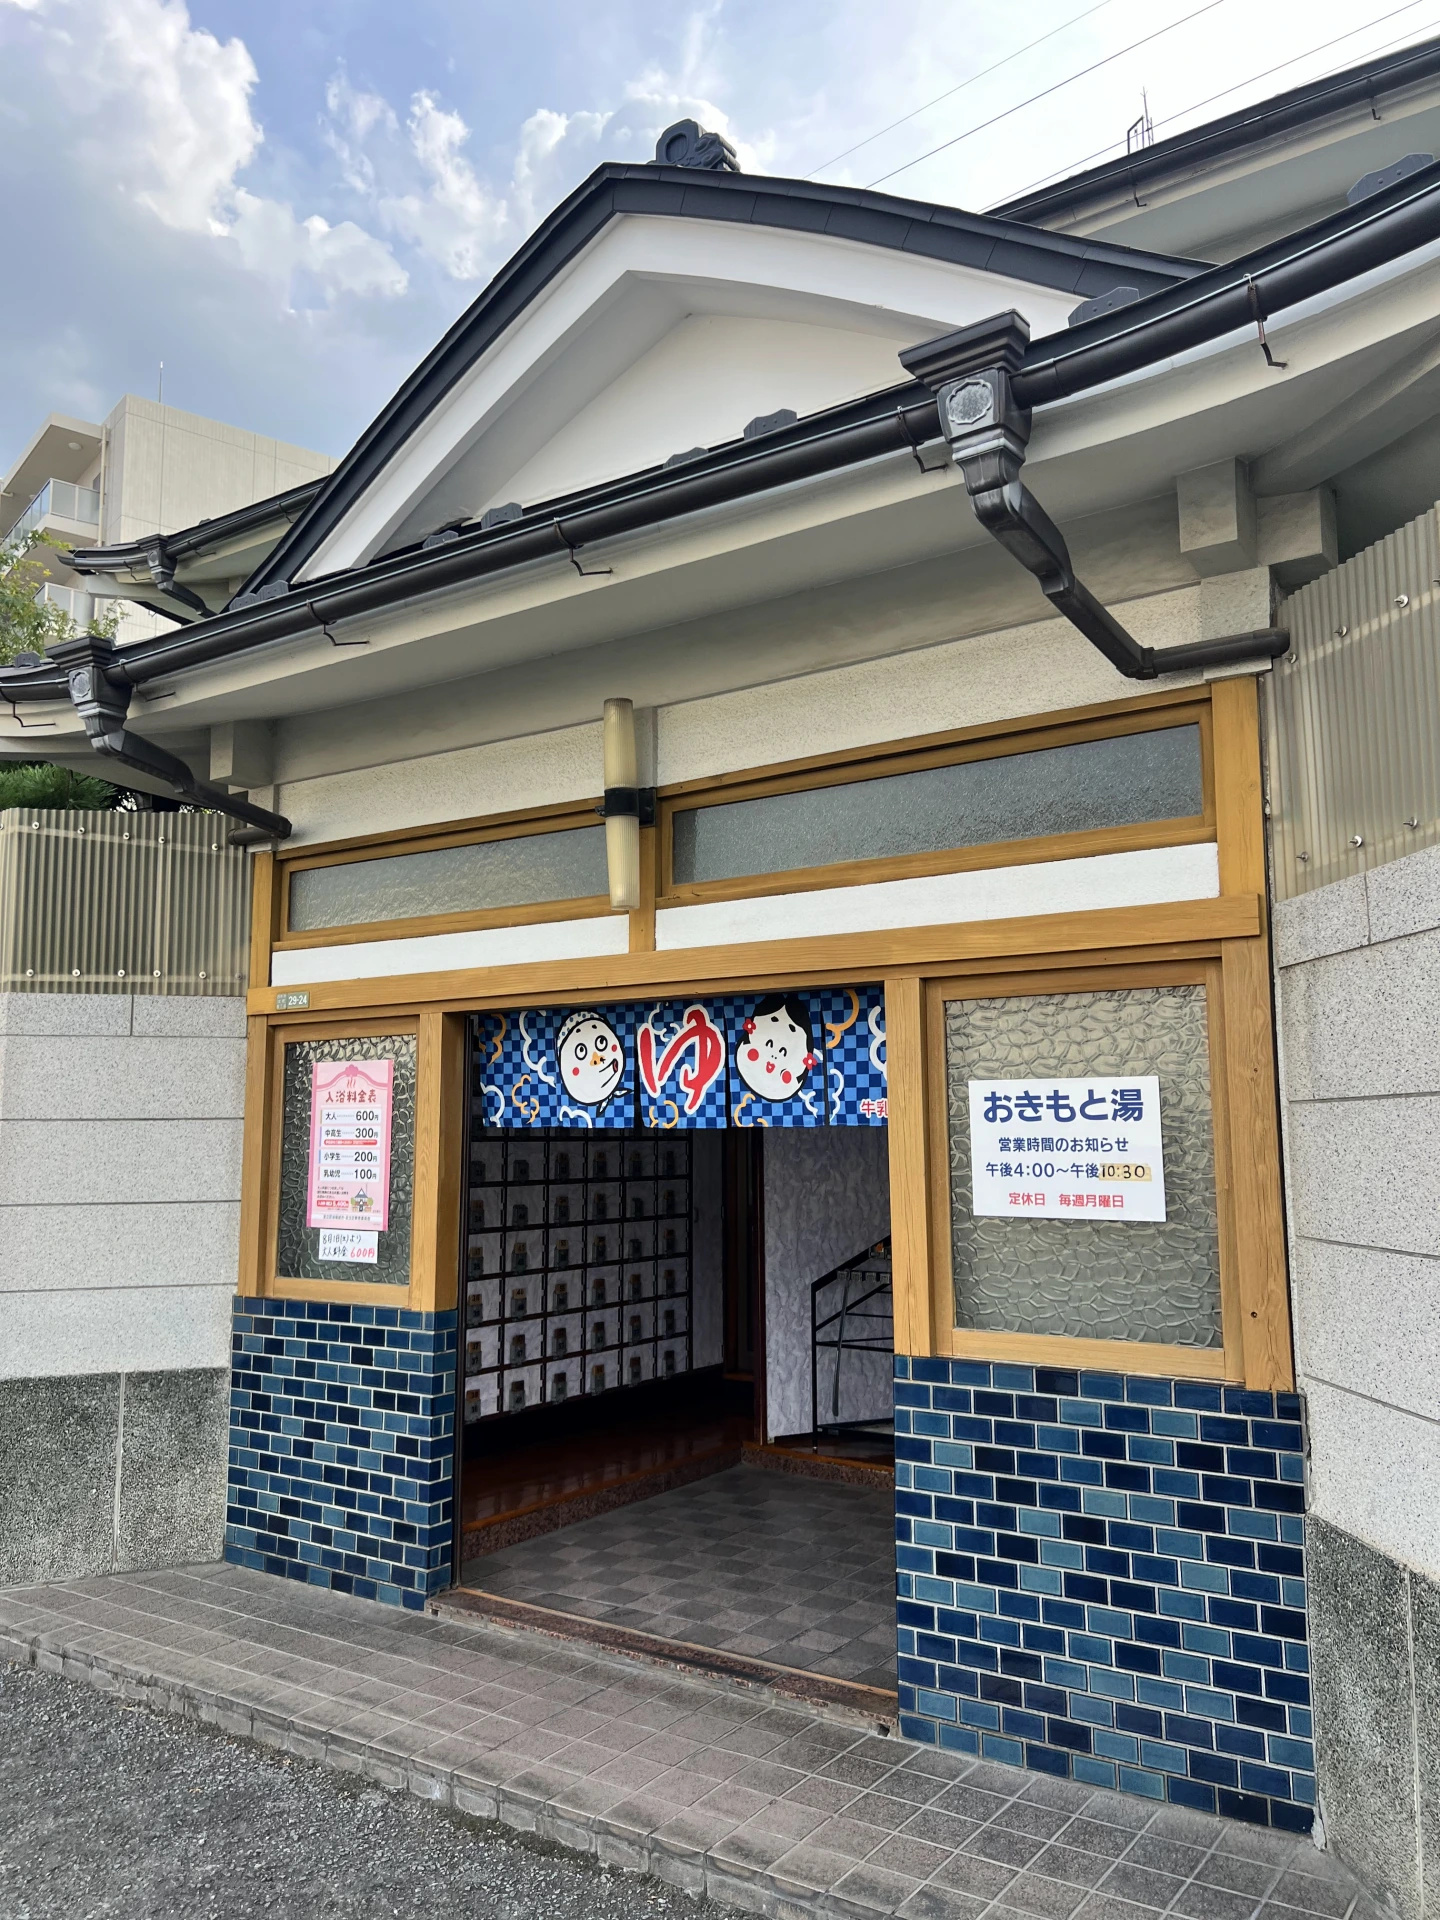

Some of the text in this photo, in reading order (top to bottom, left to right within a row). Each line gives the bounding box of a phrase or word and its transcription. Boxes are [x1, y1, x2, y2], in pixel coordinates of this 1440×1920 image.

[288, 995, 307, 1006] 29-24
[638, 1006, 725, 1112] ゆ
[325, 1089, 377, 1103] 入浴料金表
[983, 1088, 1144, 1123] おきもと湯
[325, 1112, 337, 1121] 大人
[324, 1128, 342, 1138] 中高生
[998, 1137, 1129, 1153] 営業時間のお知らせ
[323, 1151, 341, 1161] 小学生
[323, 1169, 341, 1179] 乳幼児
[1008, 1192, 1124, 1208] 定休日 毎週月曜日
[350, 1246, 375, 1258] 600円
